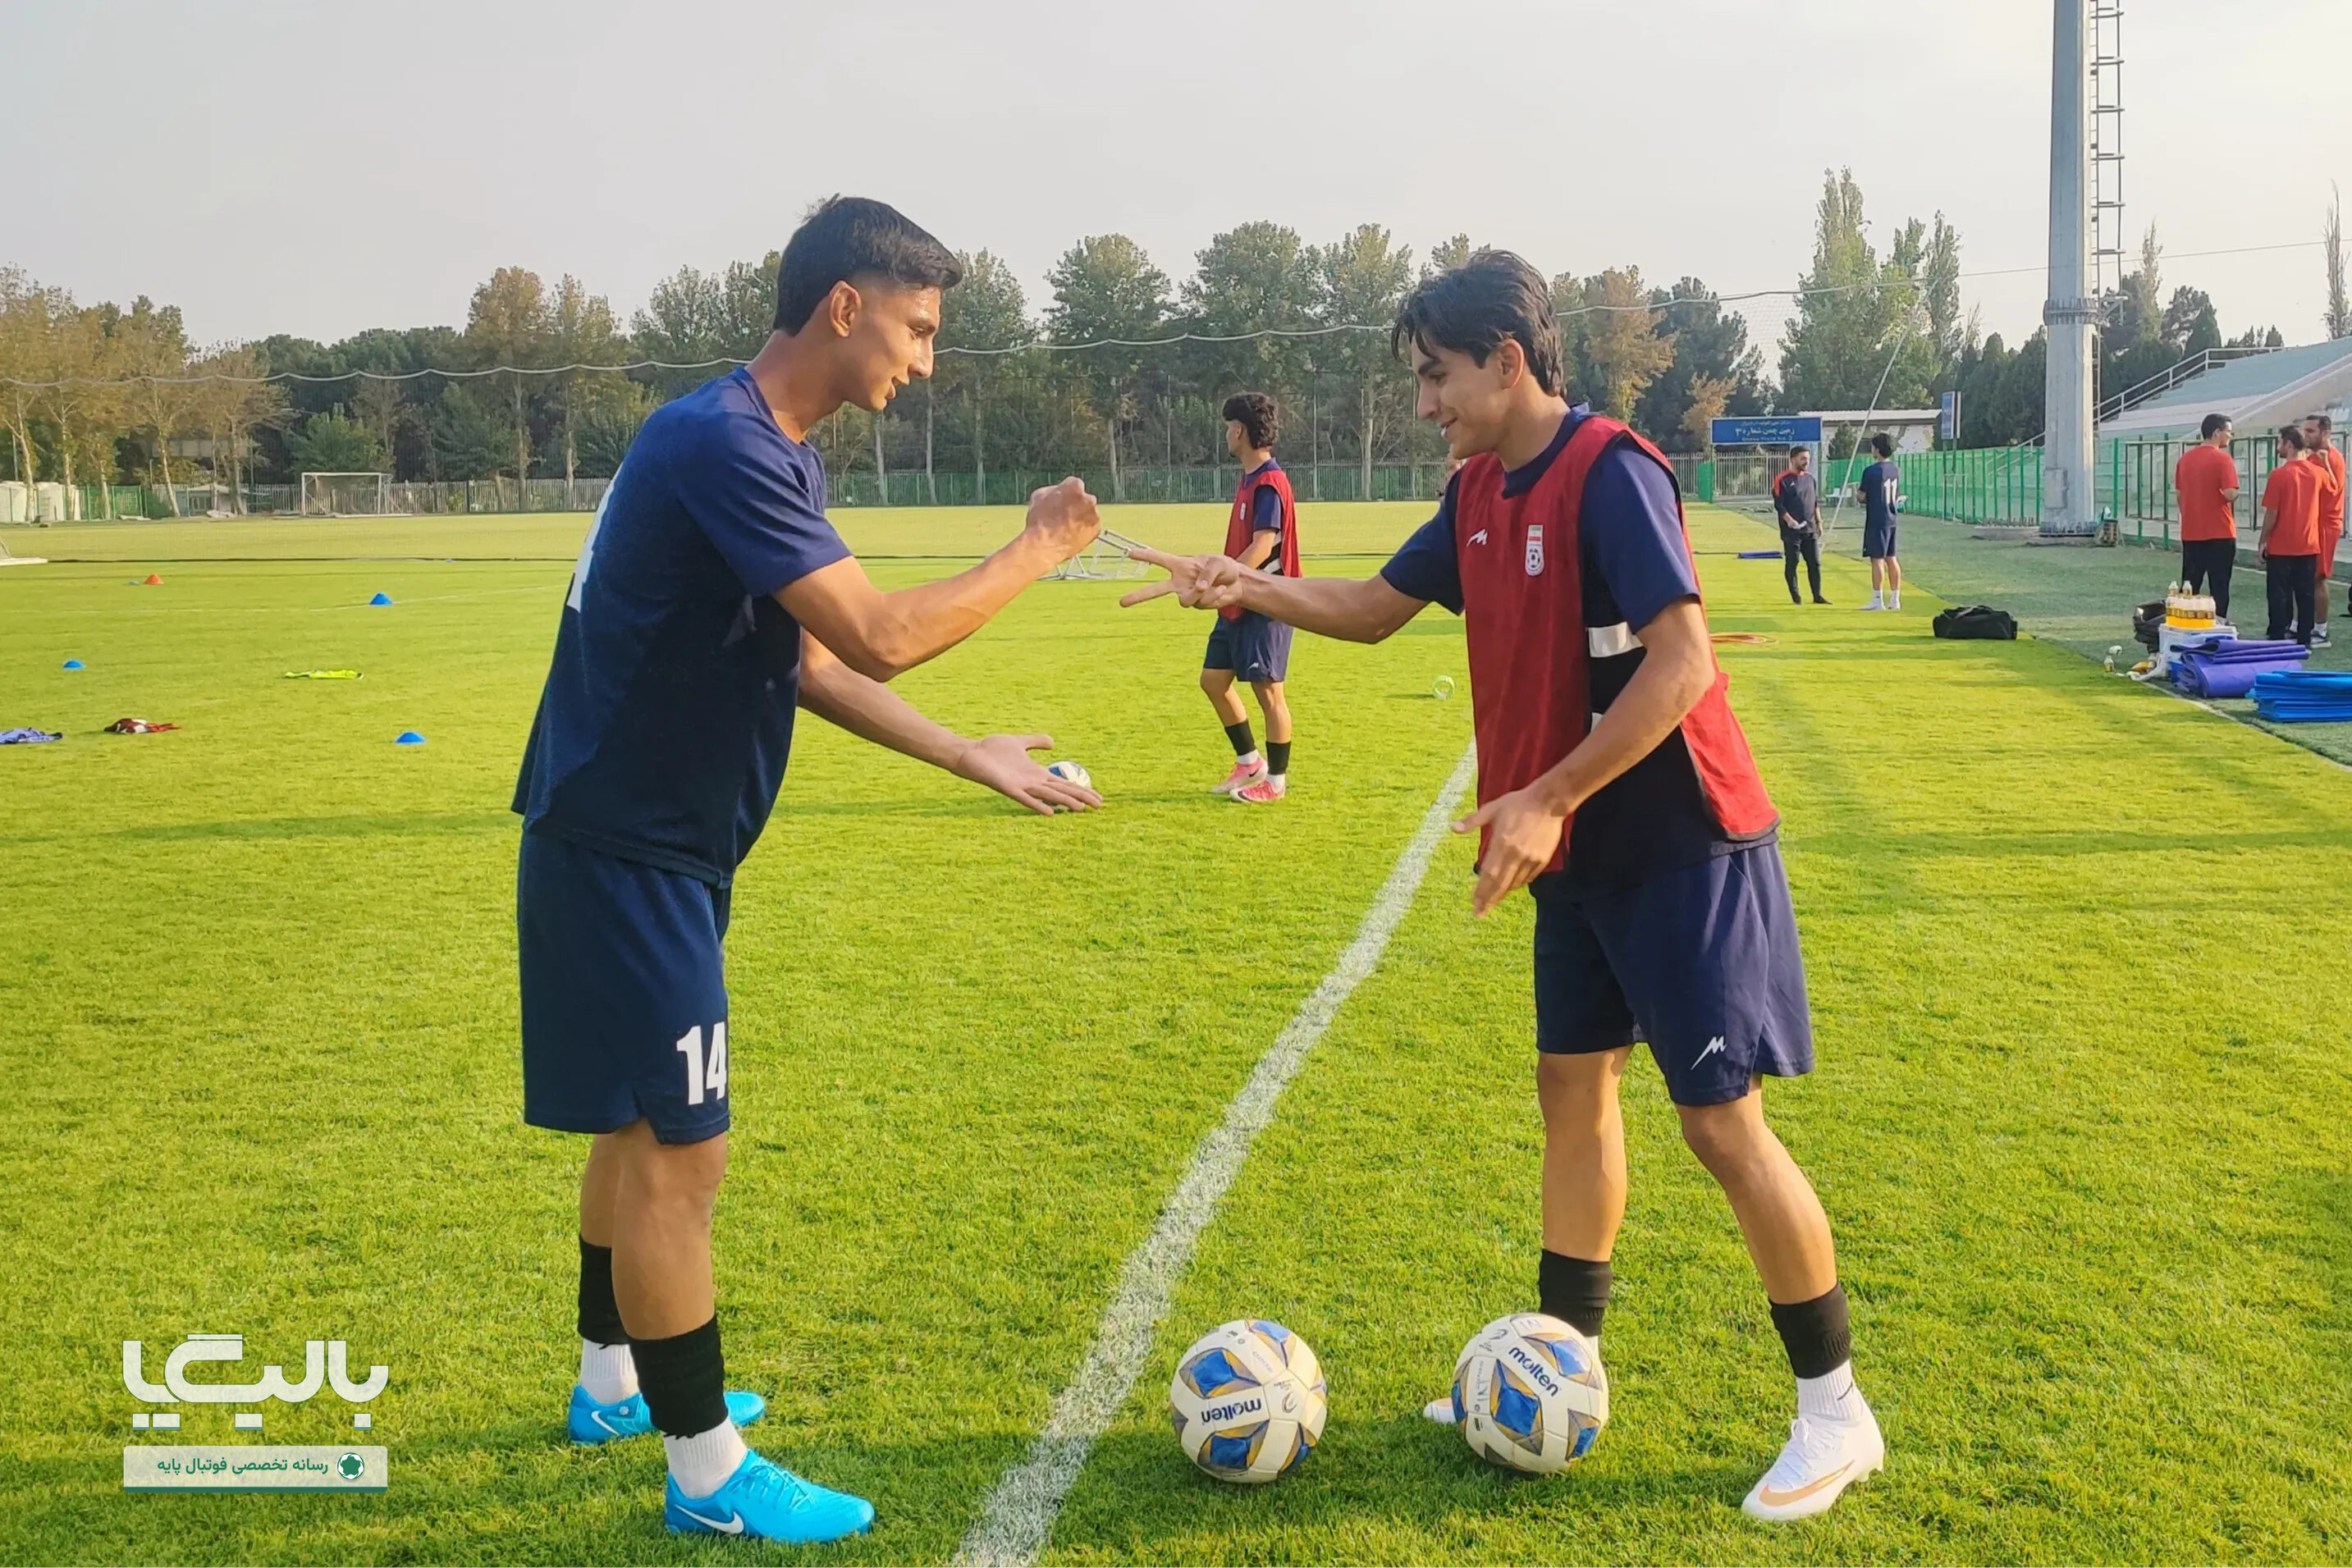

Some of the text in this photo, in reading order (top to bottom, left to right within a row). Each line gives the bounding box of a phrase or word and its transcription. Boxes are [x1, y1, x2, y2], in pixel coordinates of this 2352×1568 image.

[1884, 478, 1897, 505] 11
[676, 1022, 727, 1105] 14
[1508, 1346, 1559, 1397] molten
[1201, 1398, 1262, 1424] molten
